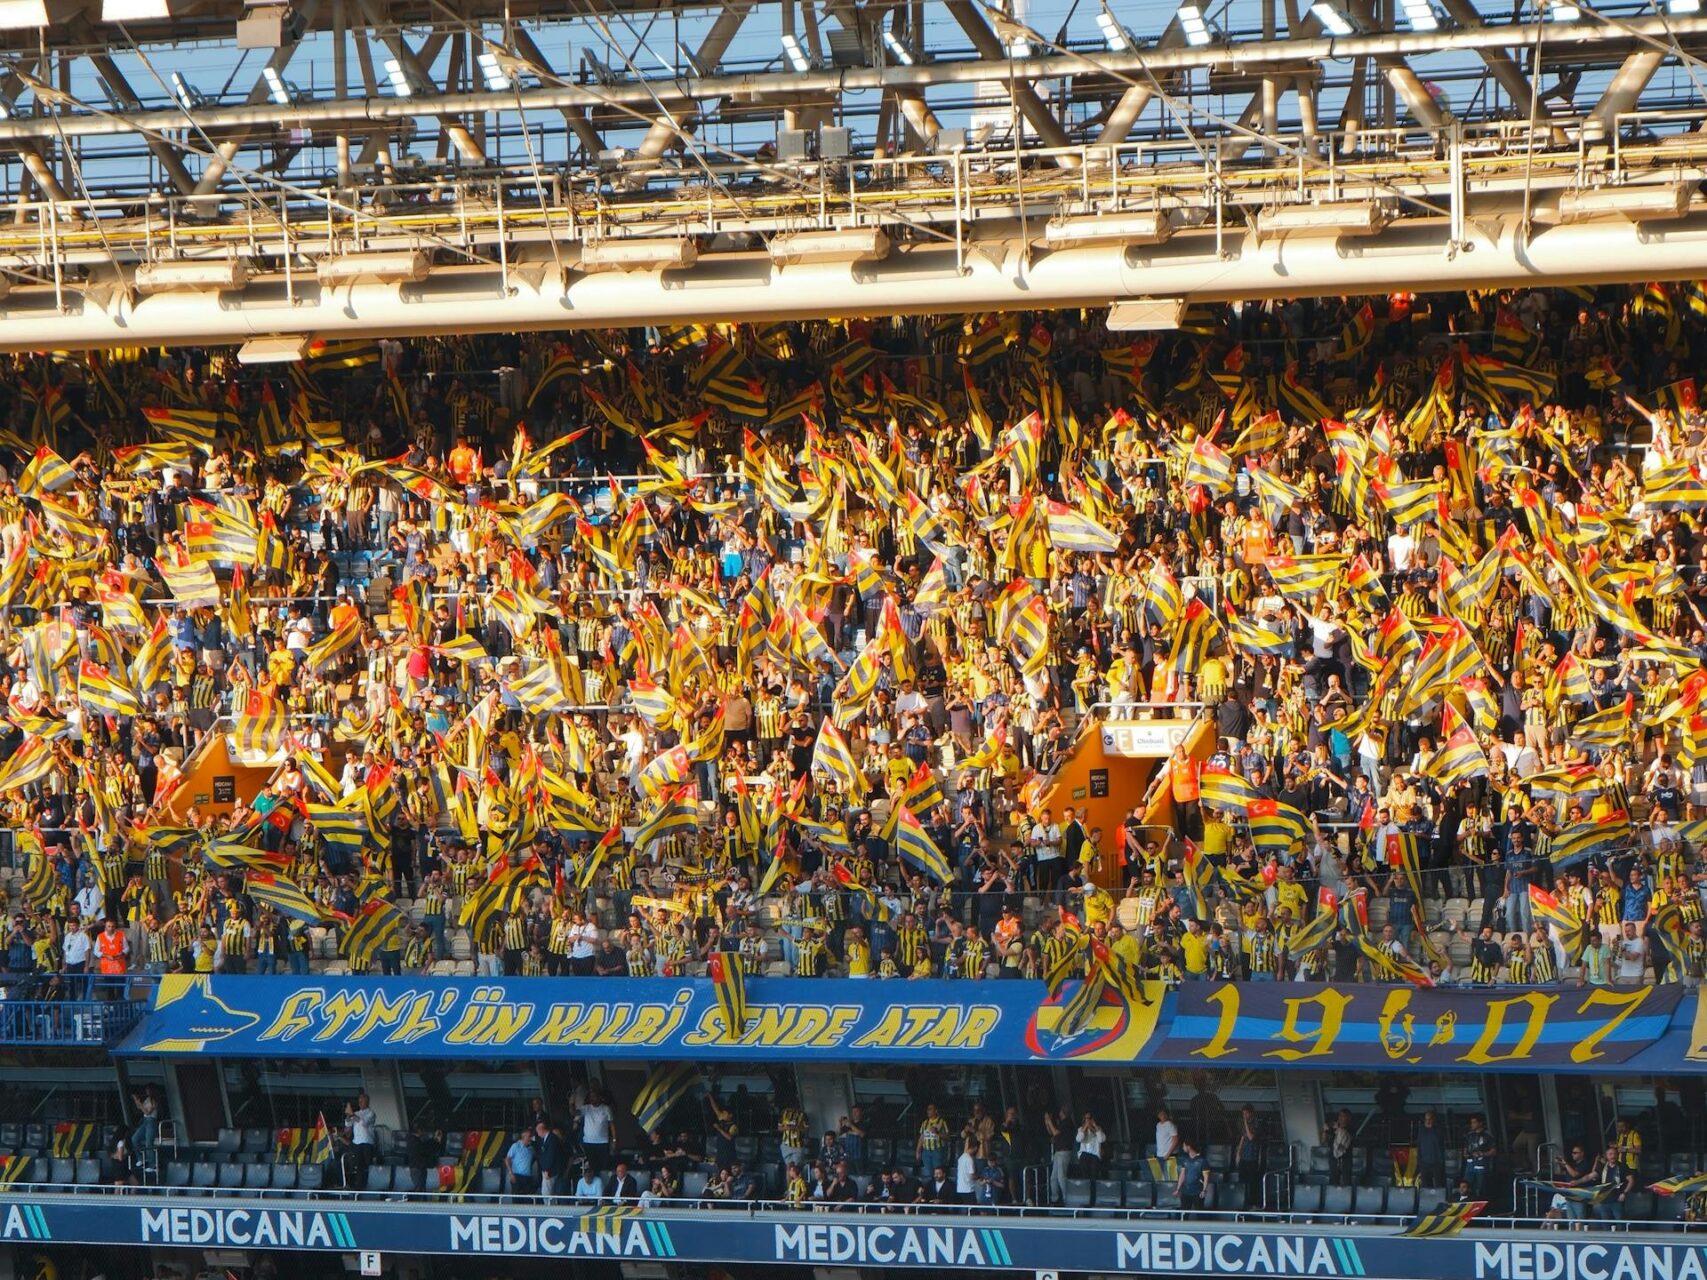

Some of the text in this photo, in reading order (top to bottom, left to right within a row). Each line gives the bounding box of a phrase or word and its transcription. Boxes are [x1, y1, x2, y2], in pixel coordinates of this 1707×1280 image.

[525, 988, 694, 1046] KALBİ
[850, 1004, 1001, 1048] ATAR
[140, 1208, 332, 1247] MEDICANA
[450, 1216, 651, 1256] MEDICANA
[775, 1224, 985, 1265] MEDICANA
[366, 1254, 375, 1269] F
[1116, 1232, 1337, 1275] MEDICANA
